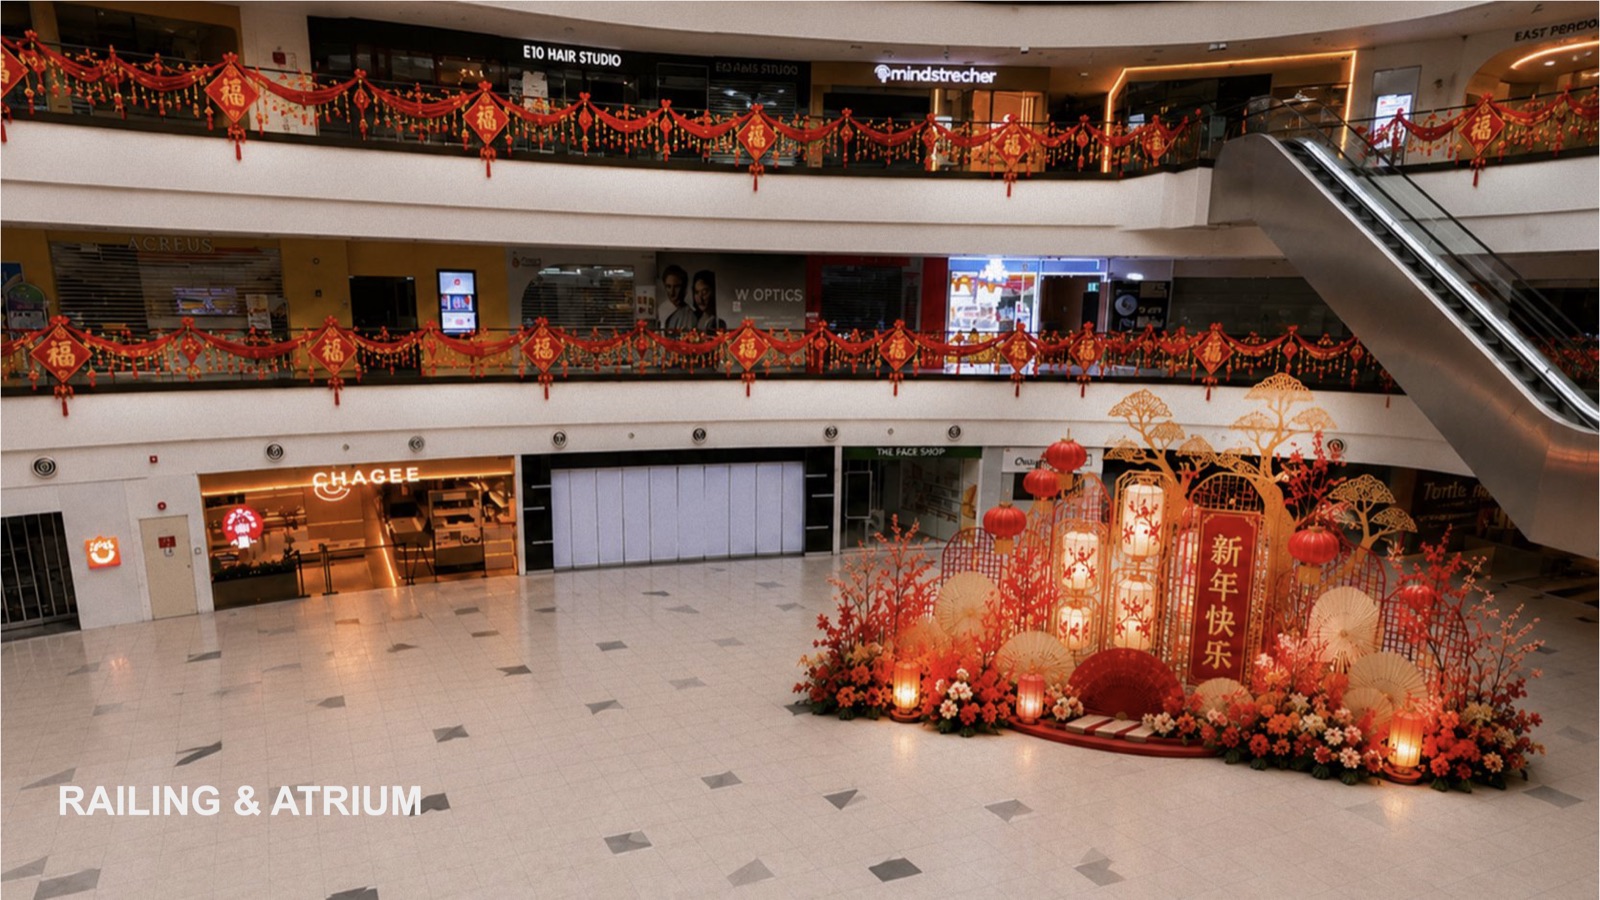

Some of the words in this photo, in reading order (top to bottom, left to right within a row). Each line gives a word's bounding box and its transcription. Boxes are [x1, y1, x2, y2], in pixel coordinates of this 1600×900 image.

[1514, 28, 1548, 42] EAST
[523, 45, 545, 59] E10
[547, 47, 576, 63] HAIR
[579, 50, 622, 67] STUDIO
[890, 66, 997, 84] mindstrecher
[220, 78, 245, 107] 福
[476, 105, 497, 131] 福
[1471, 114, 1491, 141] 福
[748, 123, 765, 148] 福
[1003, 133, 1021, 156] 福
[128, 236, 213, 254] ACREUS
[735, 288, 749, 301] W
[753, 287, 803, 302] OPTICS
[47, 341, 75, 367] 福
[322, 339, 344, 362] 福
[533, 337, 554, 359] 福
[738, 338, 757, 358] 福
[888, 337, 906, 359] 福
[876, 447, 893, 456] THE
[895, 447, 918, 456] FACE
[920, 447, 946, 456] SHOP
[312, 467, 420, 488] CHAGEE
[1202, 533, 1243, 670] 新年快乐
